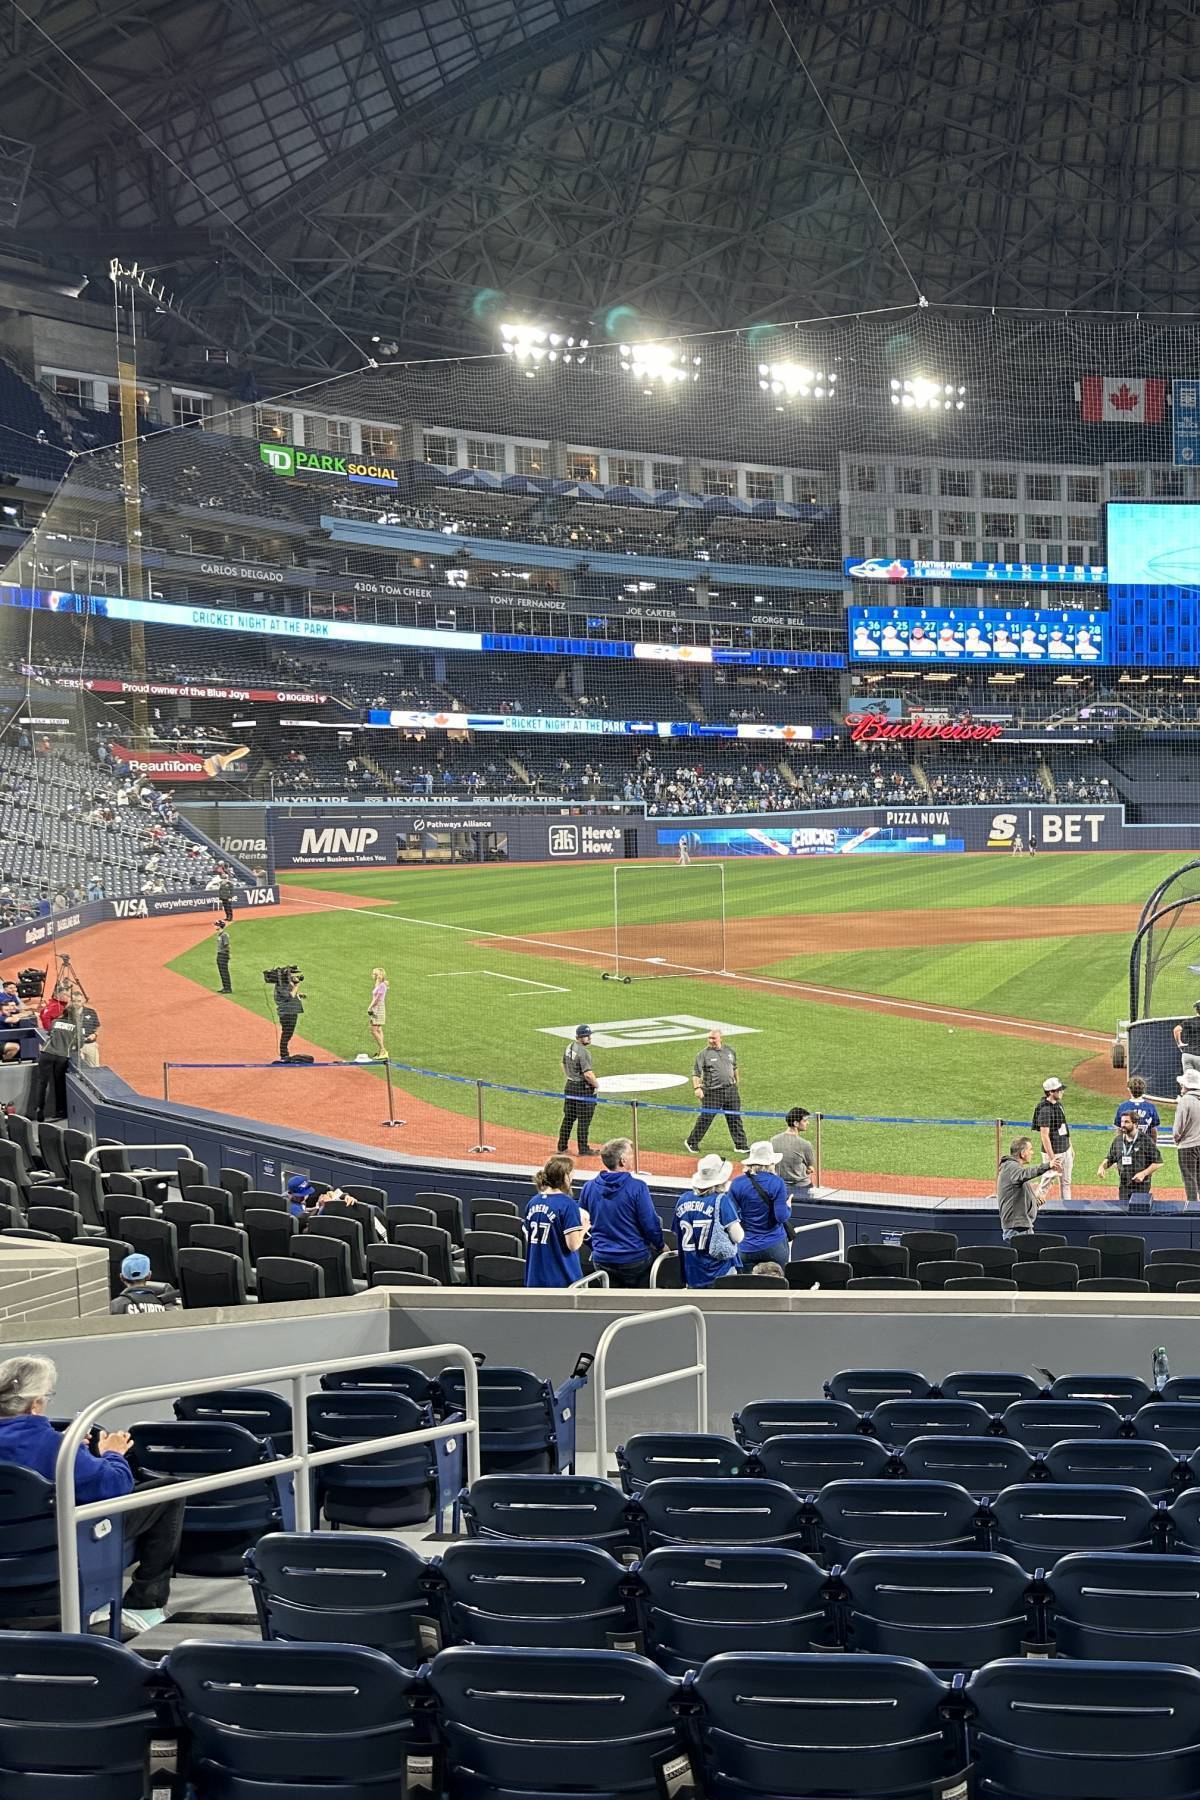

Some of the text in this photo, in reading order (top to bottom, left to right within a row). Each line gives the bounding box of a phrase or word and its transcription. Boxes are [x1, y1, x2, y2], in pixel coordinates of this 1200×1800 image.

[264, 449, 347, 472] TD PARK
[348, 464, 398, 480] SOCIAL
[200, 563, 283, 583] CARLOS DELGADO
[354, 582, 432, 598] 4306 TOM CHEEK
[489, 595, 566, 610] TONY FERNANDEZ
[626, 607, 676, 617] JOE CARTER
[192, 611, 328, 635] CRICKET NIGHT AT THE PARK
[751, 616, 804, 626] GEORGE BELL
[868, 621, 880, 630] 36
[896, 622, 908, 631] 25
[924, 622, 936, 631] 27
[957, 622, 964, 631] 2
[1011, 624, 1020, 632] 11
[1068, 625, 1074, 634] 7
[1089, 626, 1101, 634] 28
[122, 683, 315, 703] Proud owner of the Blue Jays ROGERS
[504, 717, 626, 733] CRICKET NIGHT AT THE PARK
[845, 714, 1002, 741] Budweiser
[129, 760, 202, 773] BeautiTone
[427, 820, 492, 829] Pathways Alliance
[886, 811, 950, 825] PIZZA NOVA
[582, 826, 621, 839] Here's
[990, 813, 1104, 843] S BET
[300, 828, 378, 854] MNP
[582, 840, 614, 853] How.
[111, 899, 148, 917] VISA
[154, 899, 193, 910] everywhere
[193, 898, 206, 907] you
[244, 887, 274, 905] VISA
[54, 1021, 76, 1032] SECURITY
[676, 1201, 705, 1219] GUERRERO
[530, 1221, 550, 1245] 27
[680, 1219, 713, 1251] 27
